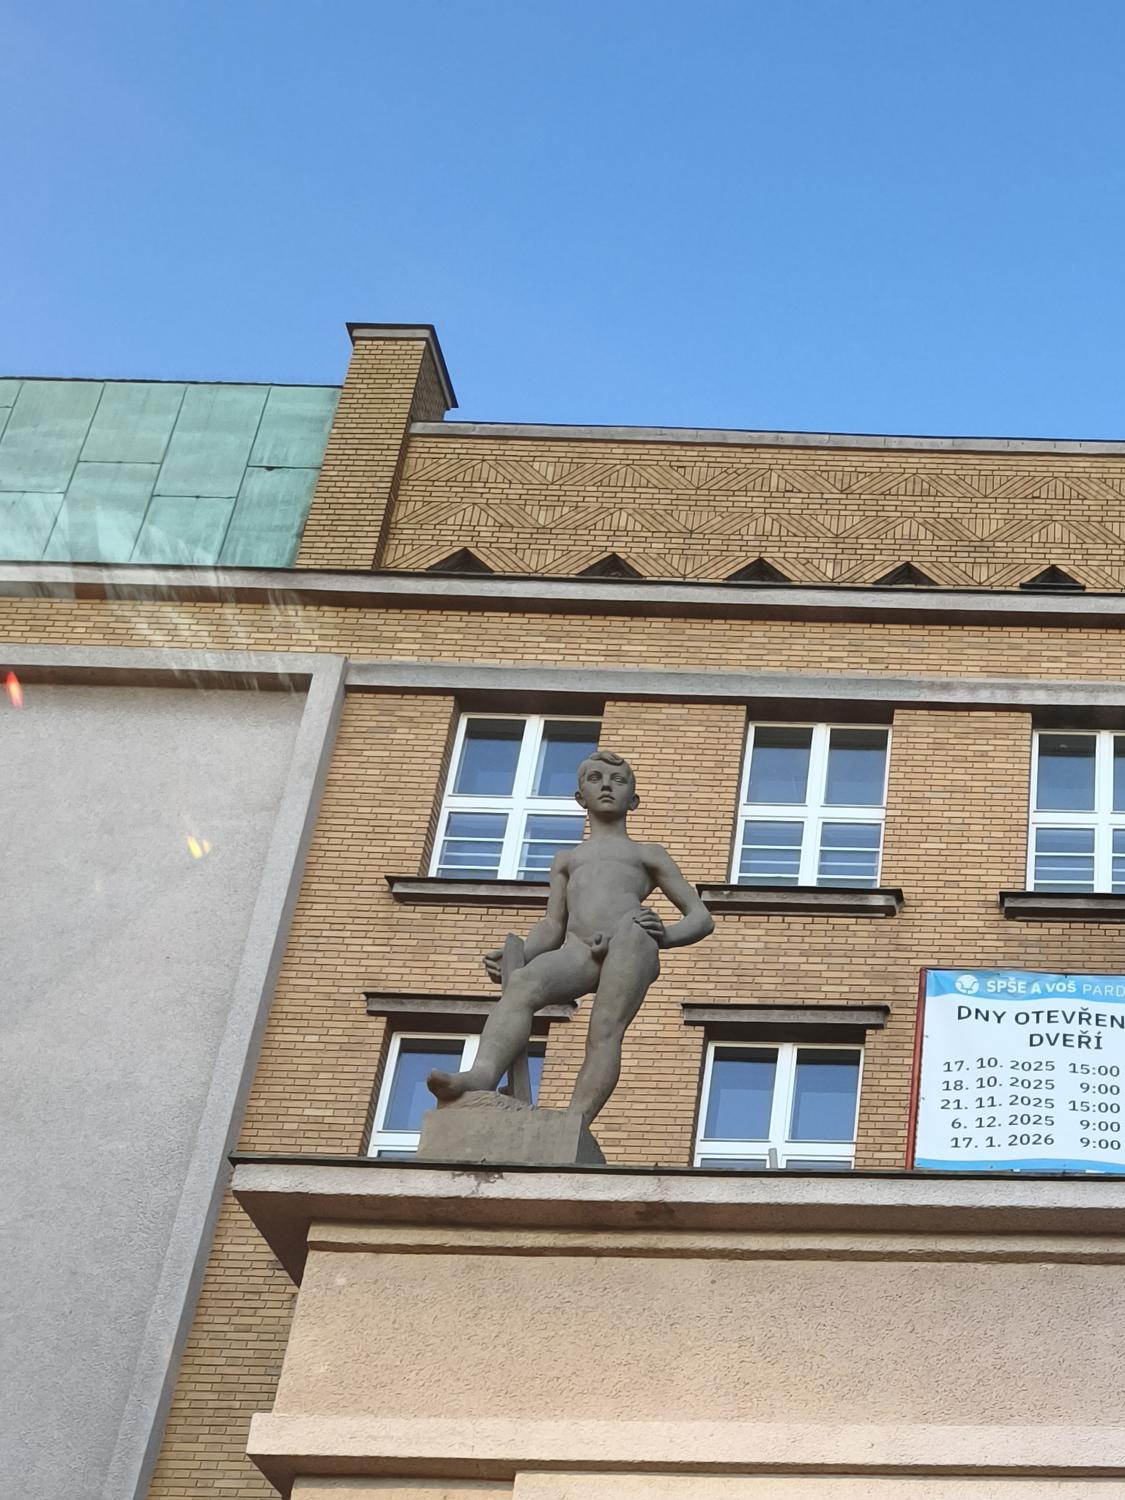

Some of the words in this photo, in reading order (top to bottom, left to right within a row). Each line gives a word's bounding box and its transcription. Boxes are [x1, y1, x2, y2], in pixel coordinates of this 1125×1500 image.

[987, 976, 1027, 994] SPŠE
[1031, 980, 1041, 994] A
[1046, 979, 1076, 993] VOŠ
[957, 1006, 1006, 1024] DNY
[1029, 1030, 1103, 1049] DVEŘÍ
[943, 1060, 970, 1072] 17.
[977, 1057, 1003, 1069] 10.
[1010, 1060, 1055, 1072] 2025
[1068, 1063, 1120, 1077] 15:00
[942, 1080, 969, 1091] 18.
[976, 1076, 1002, 1088] 10.
[1009, 1077, 1055, 1090] 2025
[1080, 1082, 1120, 1096] 9:00
[941, 1098, 968, 1110] 21.
[976, 1096, 1002, 1108] 11.
[1009, 1095, 1055, 1109] 2025
[1068, 1100, 1120, 1114] 15:00
[951, 1118, 967, 1129] 6.
[975, 1116, 1001, 1128] 12.
[1008, 1114, 1055, 1127] 2025
[1080, 1119, 1120, 1132] 9:00
[950, 1136, 978, 1149] 17.
[986, 1136, 1000, 1147] 1.
[1008, 1134, 1054, 1146] 2026
[1080, 1137, 1121, 1151] 9:00
